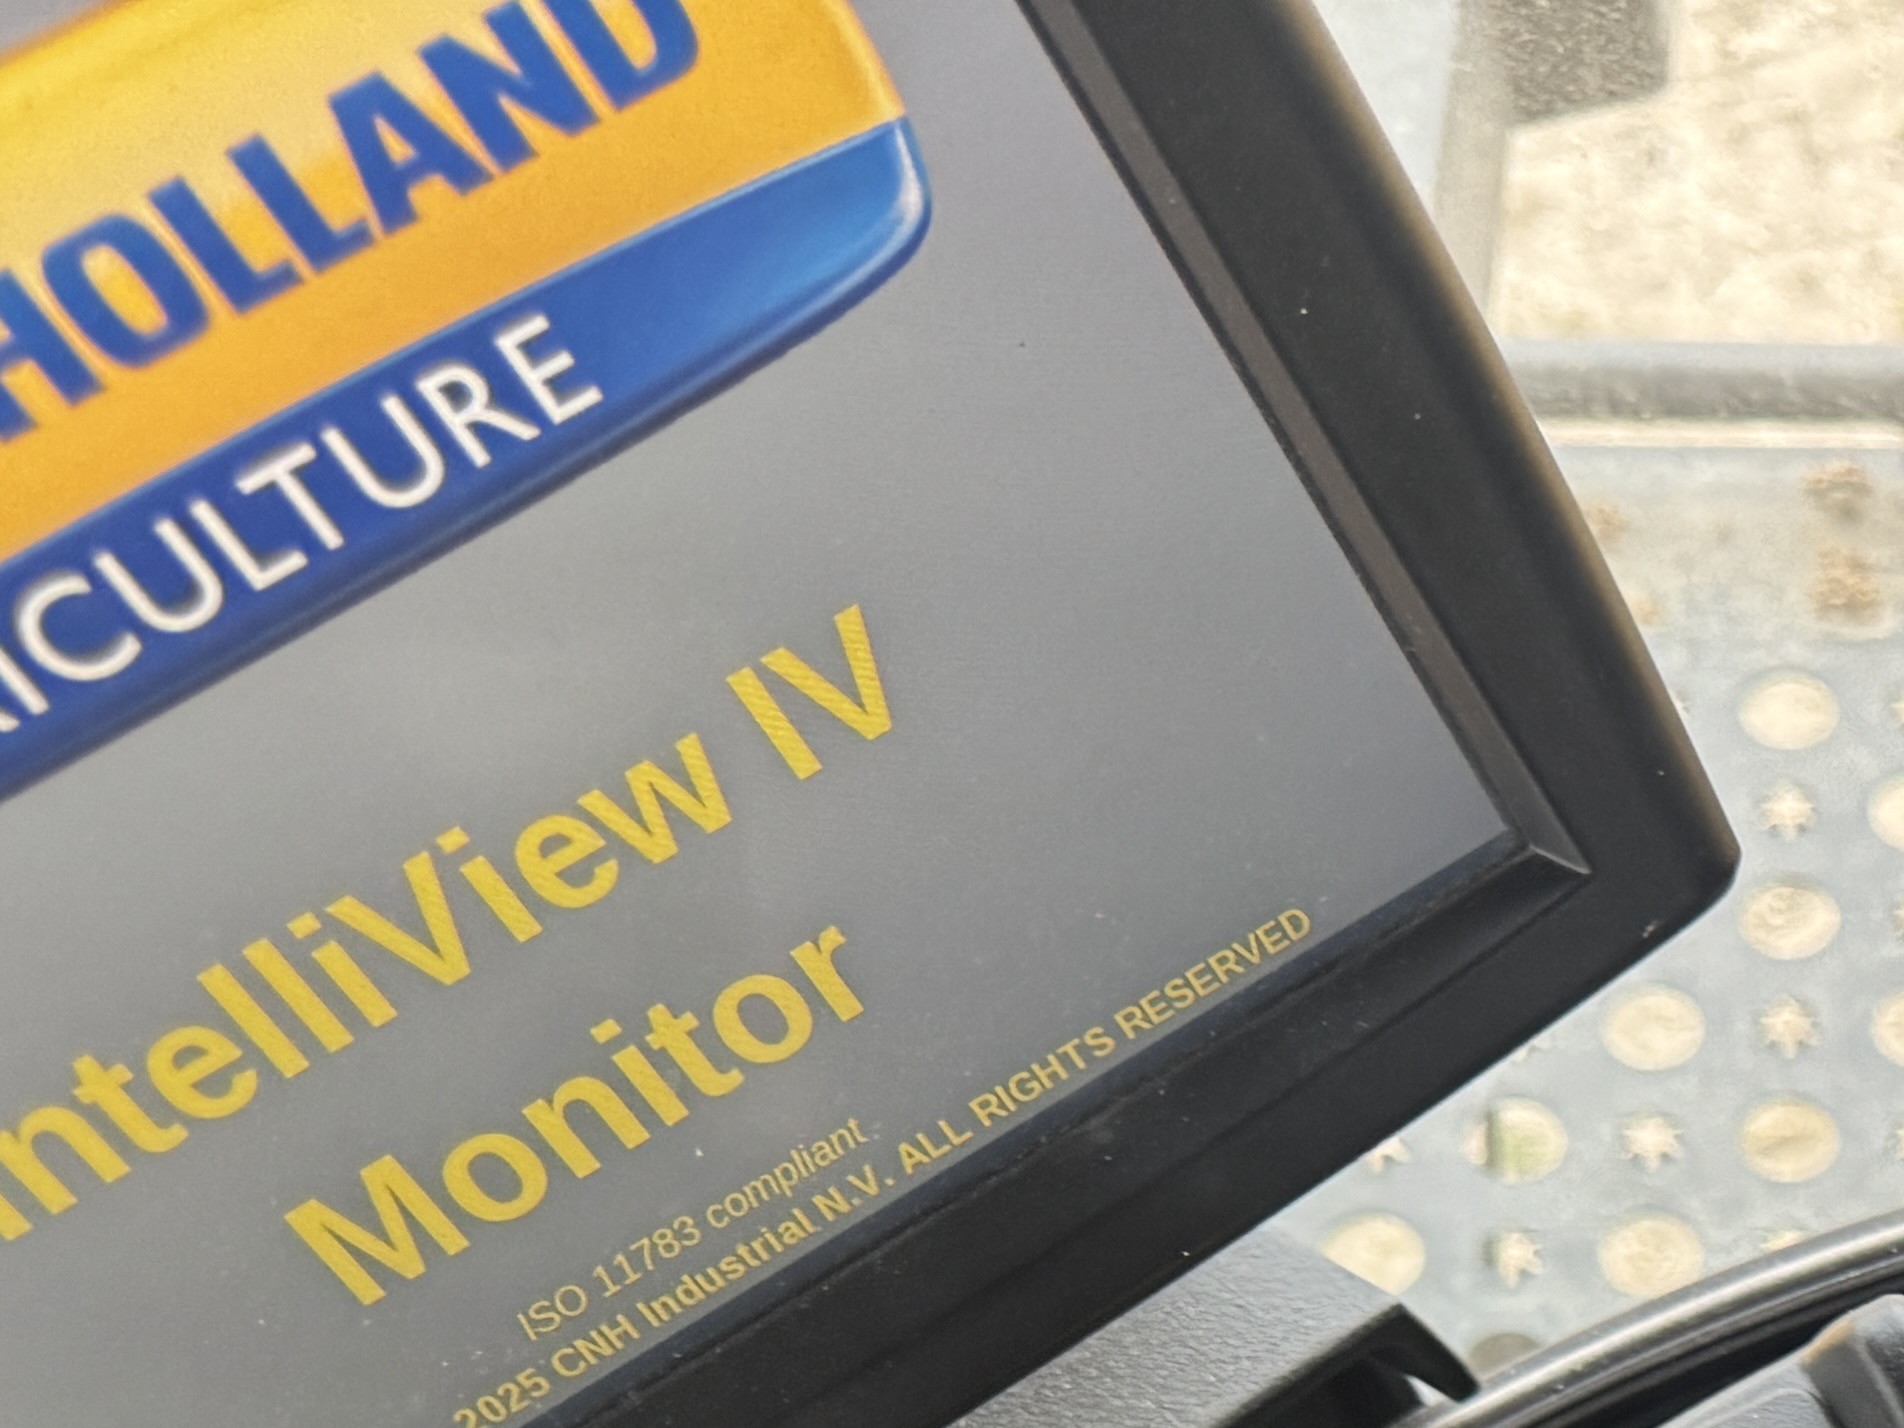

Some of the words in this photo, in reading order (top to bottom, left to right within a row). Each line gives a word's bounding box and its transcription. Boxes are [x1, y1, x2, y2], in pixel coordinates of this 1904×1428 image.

[726, 604, 892, 780] IV
[284, 925, 865, 1307] Monitor
[517, 1284, 589, 1342] ISO
[591, 1216, 700, 1299] 11783
[705, 1115, 869, 1235] compliant
[550, 1312, 639, 1380] CNH
[642, 1207, 818, 1327] Industrial
[812, 1168, 894, 1222] N.V.
[897, 1121, 974, 1175] ALL
[968, 1026, 1116, 1128] RIGHTS
[1114, 907, 1314, 1041] RESERVED
